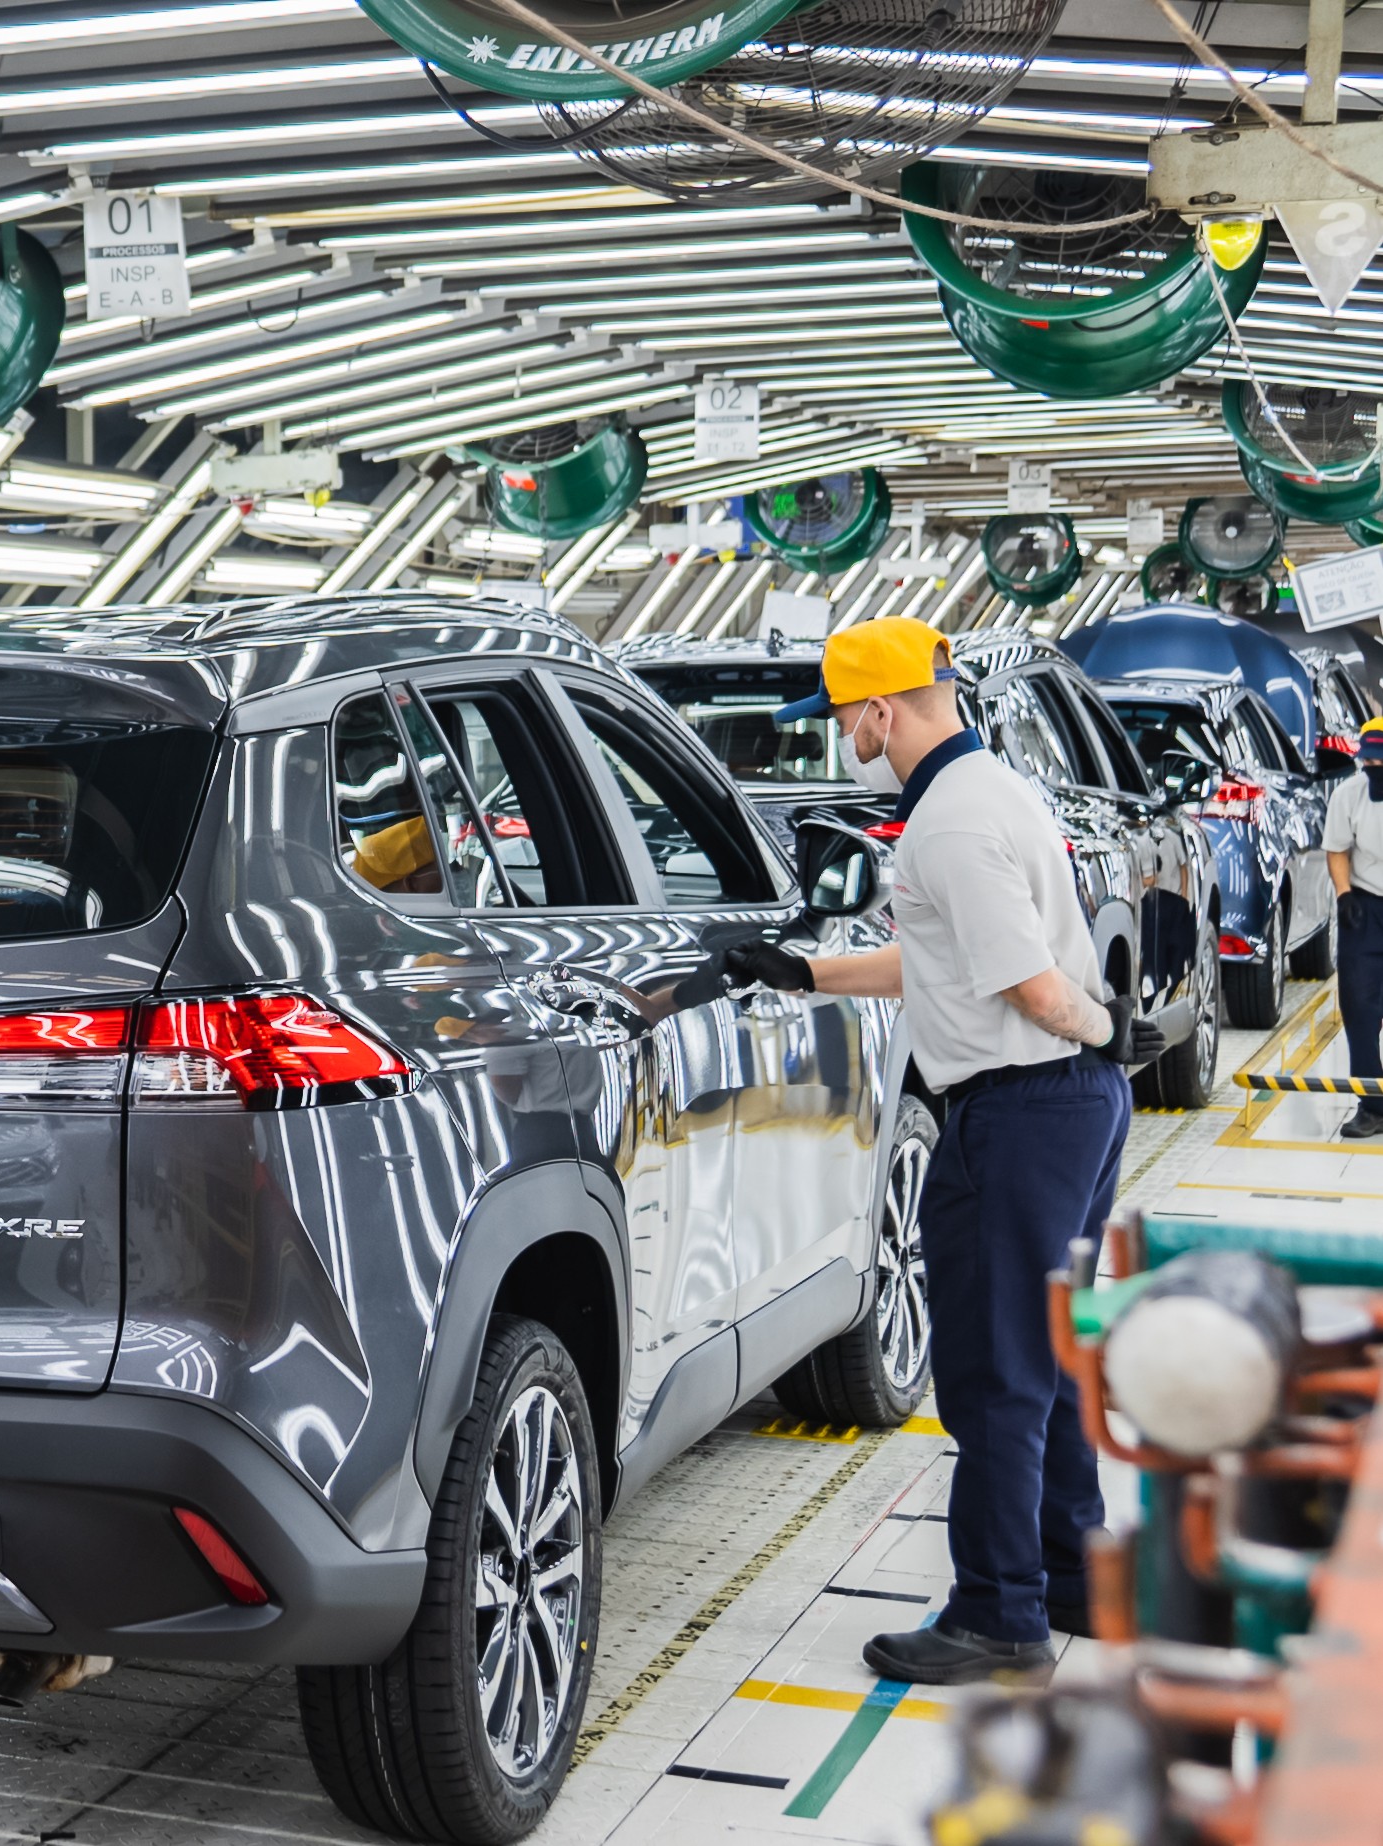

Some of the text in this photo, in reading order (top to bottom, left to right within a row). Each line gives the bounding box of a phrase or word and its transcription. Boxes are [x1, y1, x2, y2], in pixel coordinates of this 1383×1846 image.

[107, 196, 152, 235] 01
[102, 244, 166, 257] PROCESSOS
[110, 265, 161, 283] INSP.
[99, 291, 112, 308] E
[130, 290, 143, 306] A
[161, 288, 174, 305] B
[710, 386, 742, 410] 02
[1318, 559, 1365, 579] ATENÇÃO
